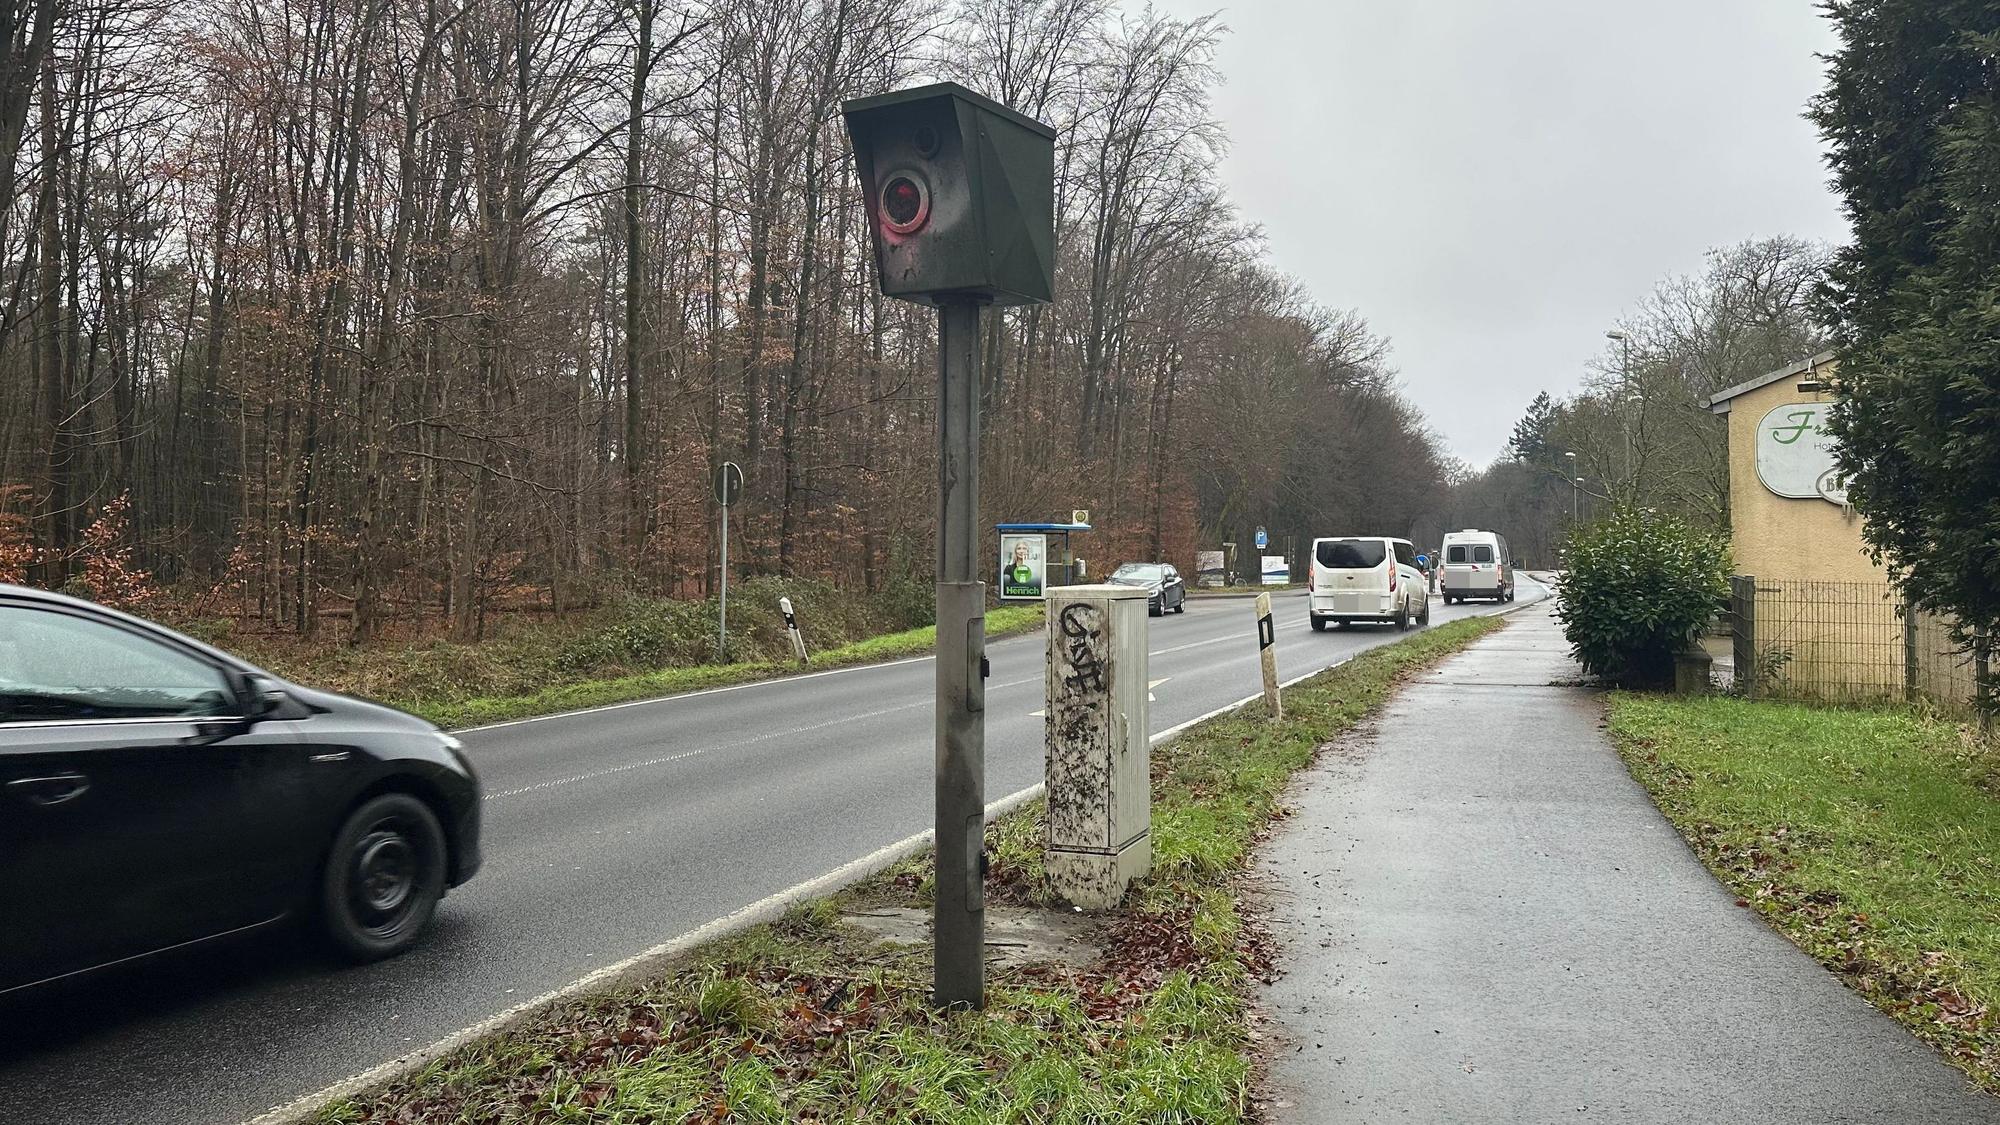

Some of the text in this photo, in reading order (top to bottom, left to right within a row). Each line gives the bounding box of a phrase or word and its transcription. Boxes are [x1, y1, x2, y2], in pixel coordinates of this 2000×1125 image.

[1768, 411, 1824, 444] Fr
[1257, 531, 1265, 541] P
[1006, 586, 1040, 595] Henrich
